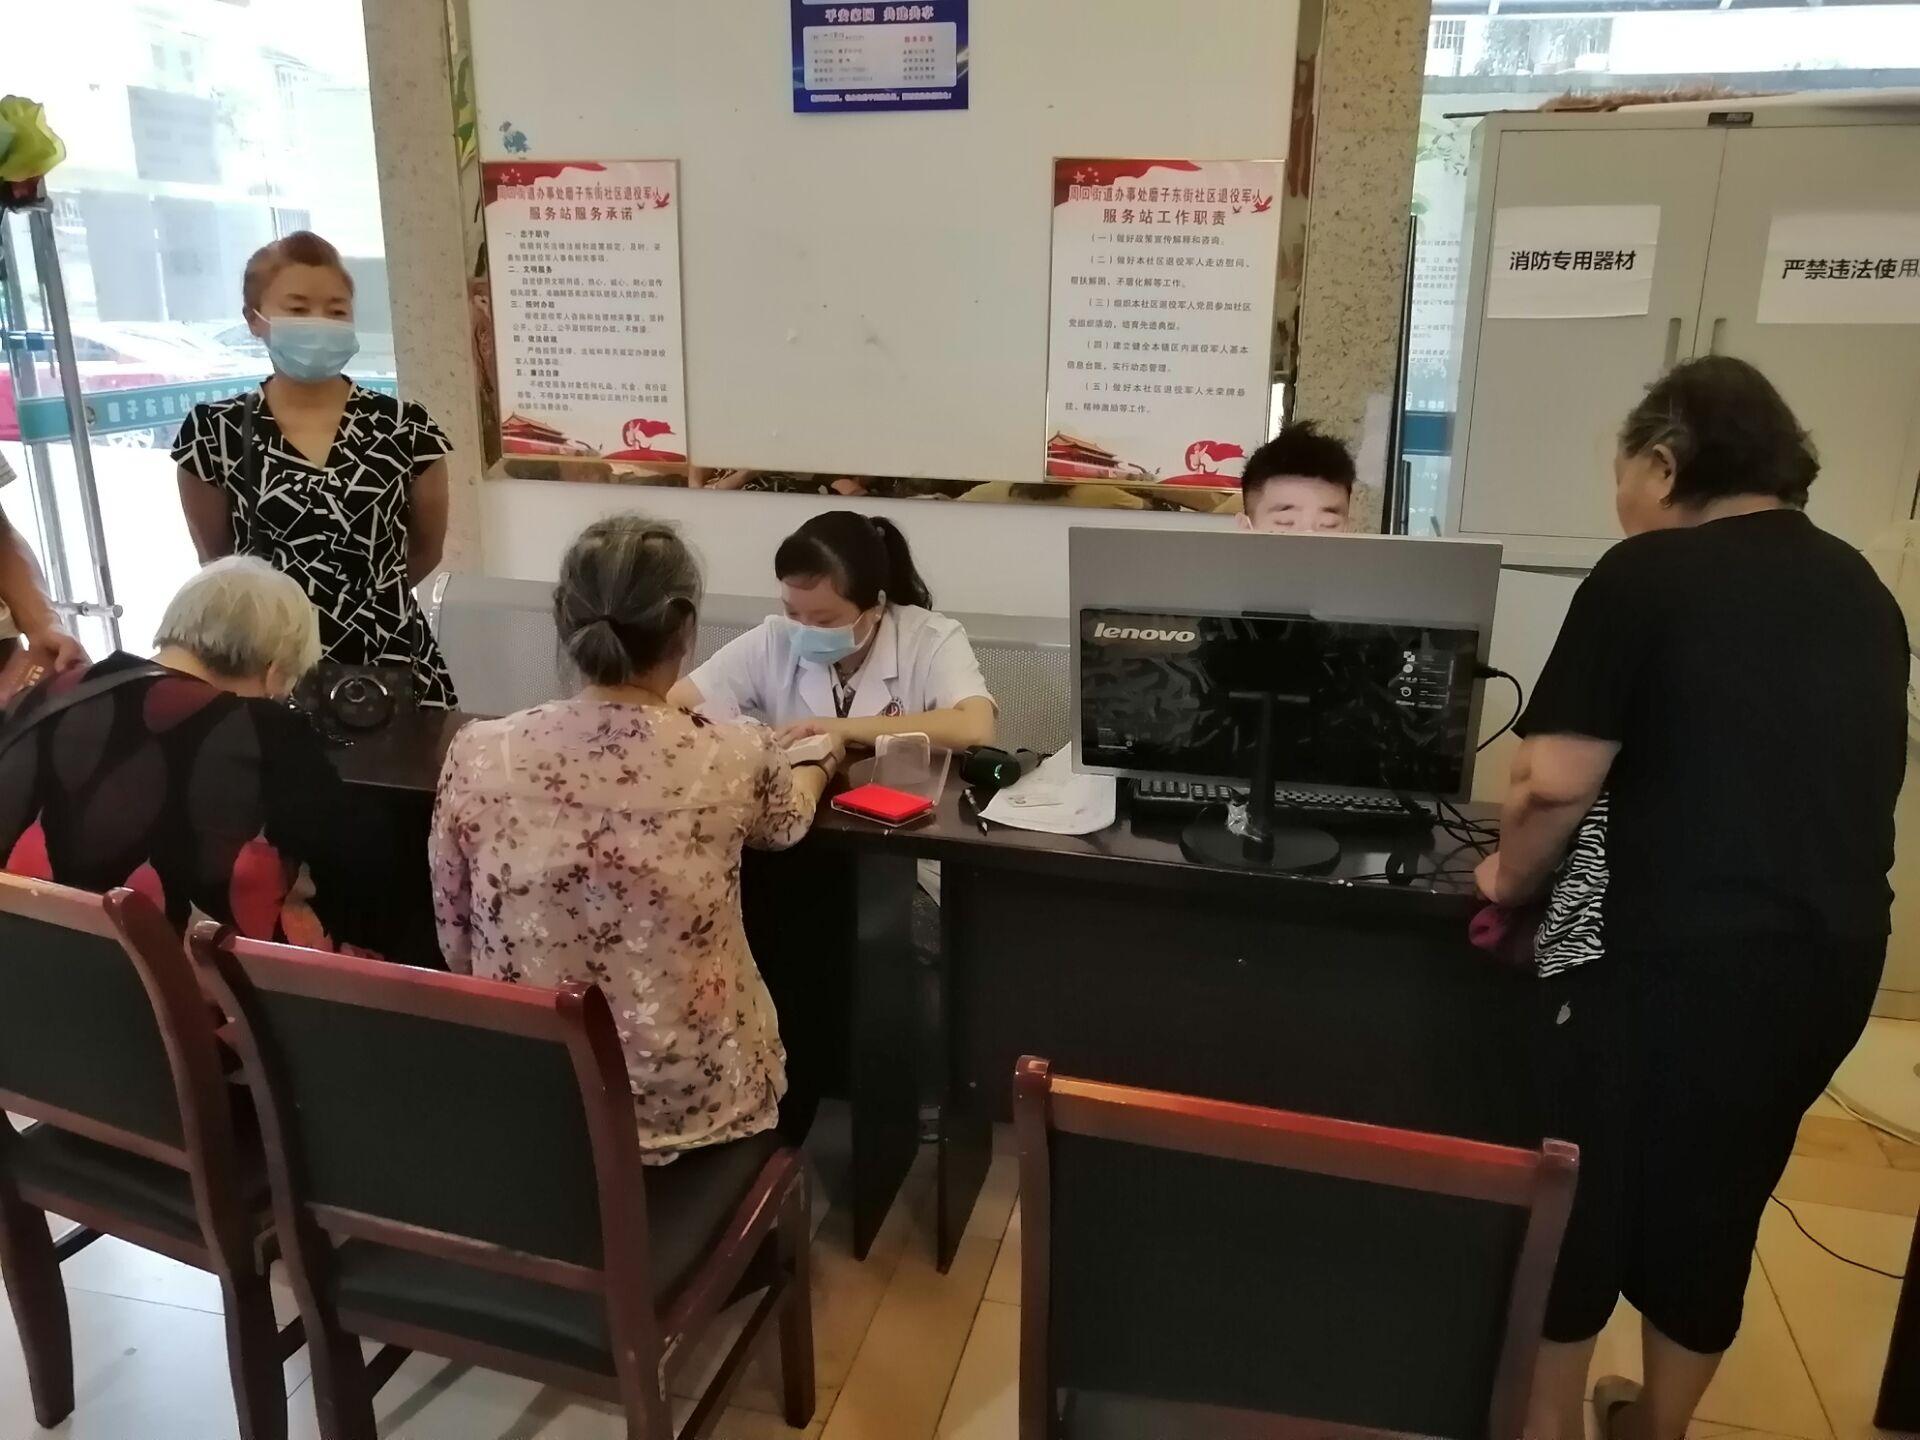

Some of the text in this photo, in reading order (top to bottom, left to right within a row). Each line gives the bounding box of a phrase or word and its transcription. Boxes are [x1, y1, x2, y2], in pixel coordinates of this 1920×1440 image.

[529, 206, 633, 221] 服务站服务承诺
[1103, 208, 1226, 226] 服务站工作职责
[1509, 250, 1636, 271] 消防专用器材
[1094, 622, 1196, 643] lenovo
